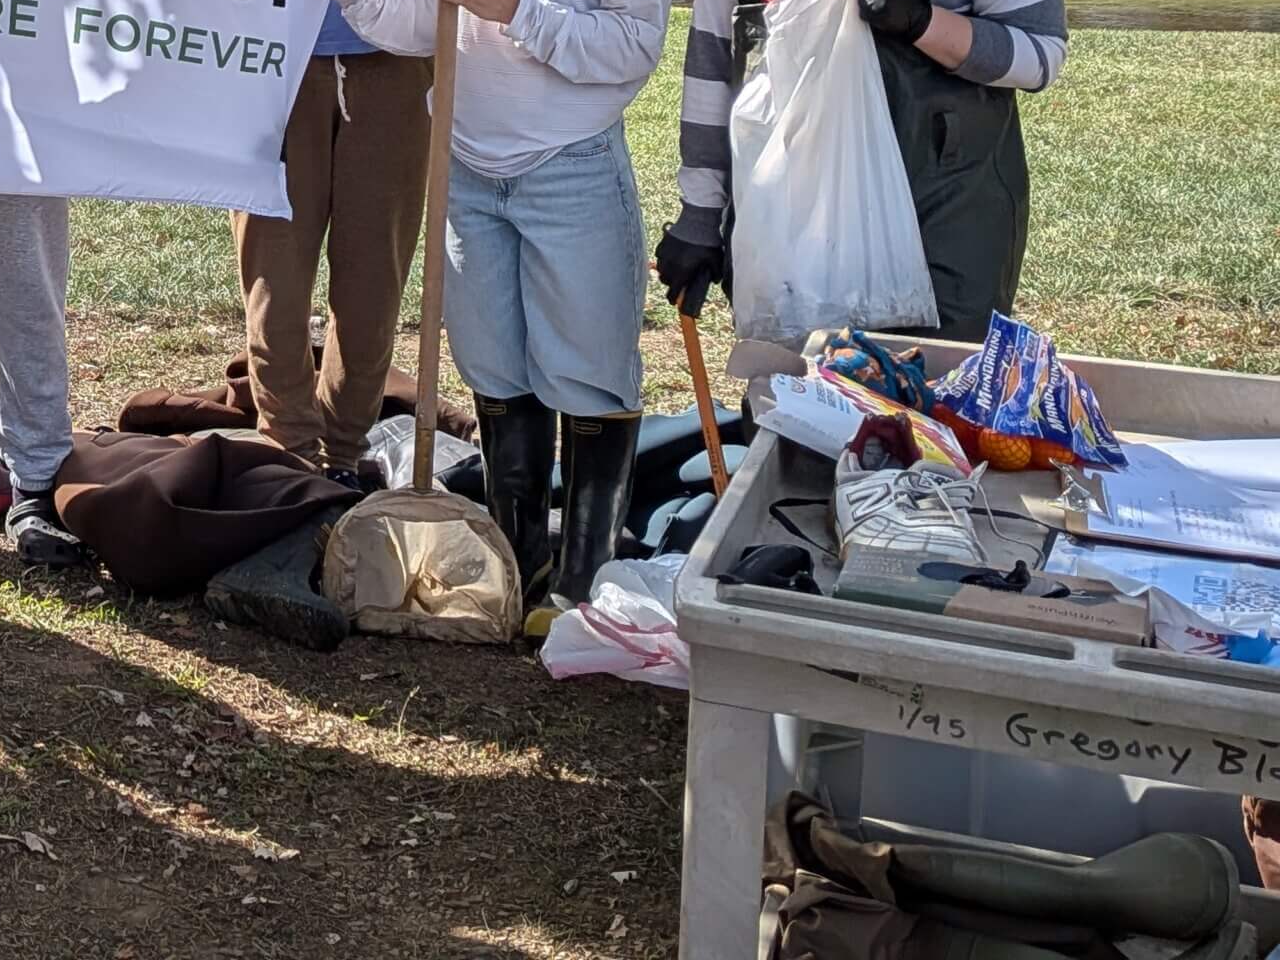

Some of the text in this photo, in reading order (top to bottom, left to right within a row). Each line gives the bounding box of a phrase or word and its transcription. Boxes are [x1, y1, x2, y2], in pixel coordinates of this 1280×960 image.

[73, 7, 286, 78] FOREVER
[899, 704, 966, 738] 1/95
[1006, 712, 1192, 776] Gregory
